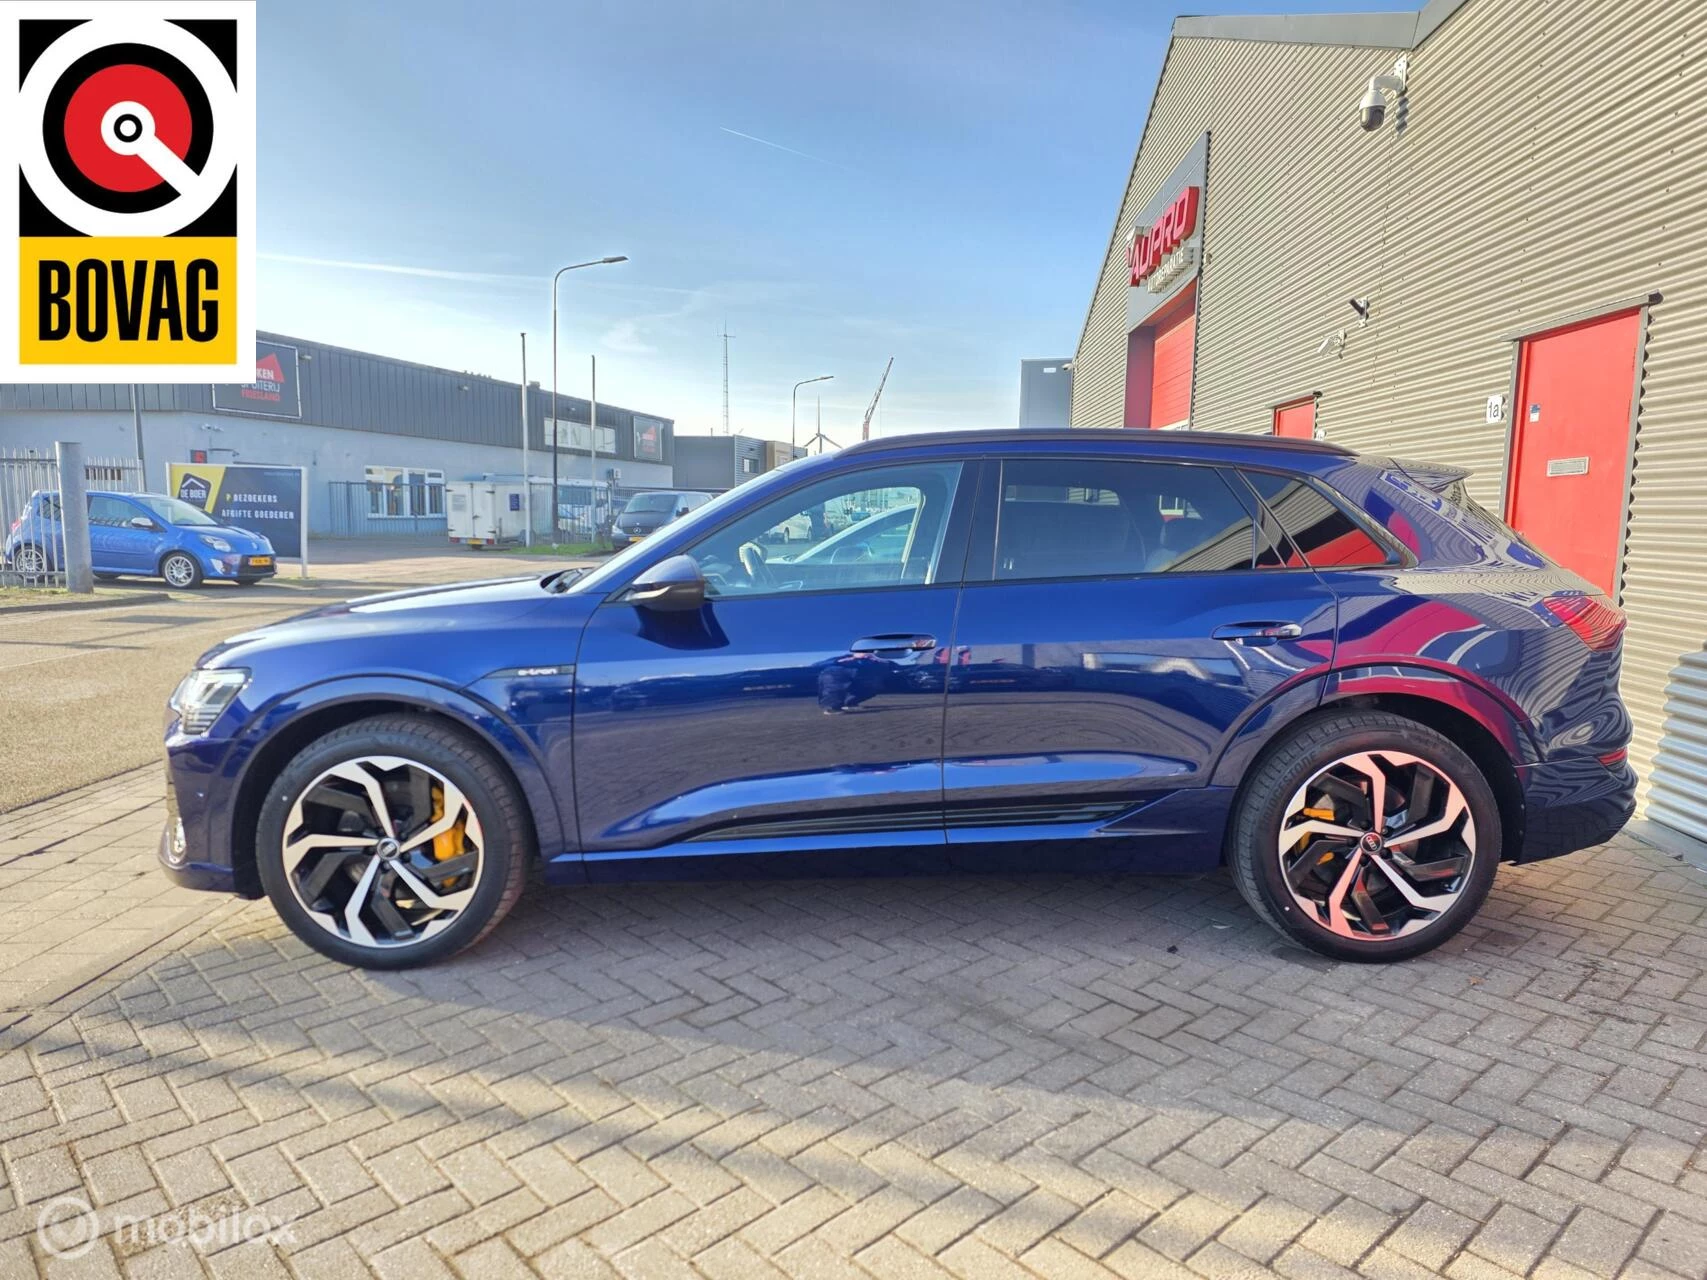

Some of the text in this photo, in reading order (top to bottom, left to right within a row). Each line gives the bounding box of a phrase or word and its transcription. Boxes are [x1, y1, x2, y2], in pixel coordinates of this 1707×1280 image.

[1488, 401, 1500, 418] 1a
[180, 489, 206, 498] DE BOER
[233, 493, 278, 503] BEZOEKERS
[221, 508, 295, 520] AFGIFTE GOEDEREN
